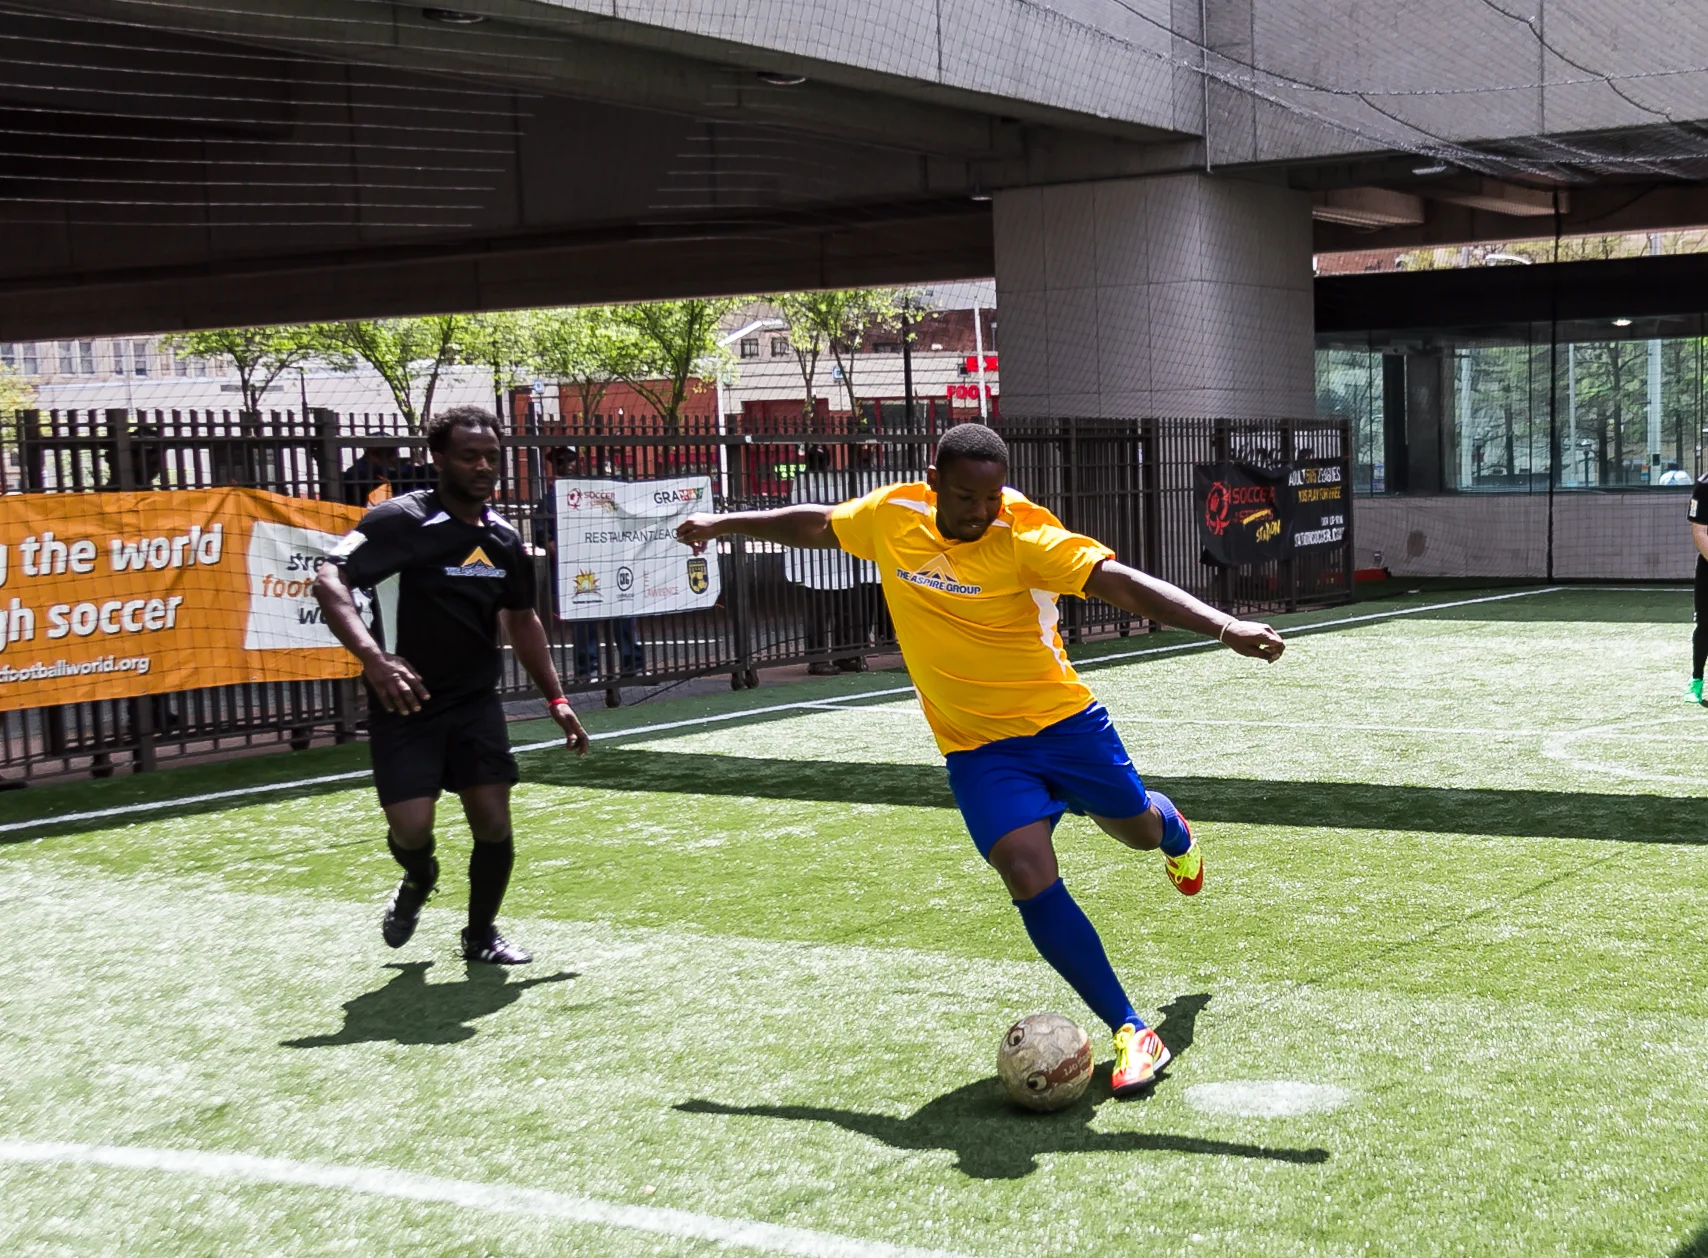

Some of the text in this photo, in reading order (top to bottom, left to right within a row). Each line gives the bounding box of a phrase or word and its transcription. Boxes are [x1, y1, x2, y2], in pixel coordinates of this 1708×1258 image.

[1232, 486, 1275, 504] SOCCER
[20, 531, 98, 576] the
[110, 523, 224, 573] world
[585, 531, 655, 544] RESTAURANT
[287, 552, 328, 573] stre
[262, 573, 314, 598] foot
[896, 568, 981, 595] THE ASPIRE GROUP
[47, 595, 184, 640] soccer
